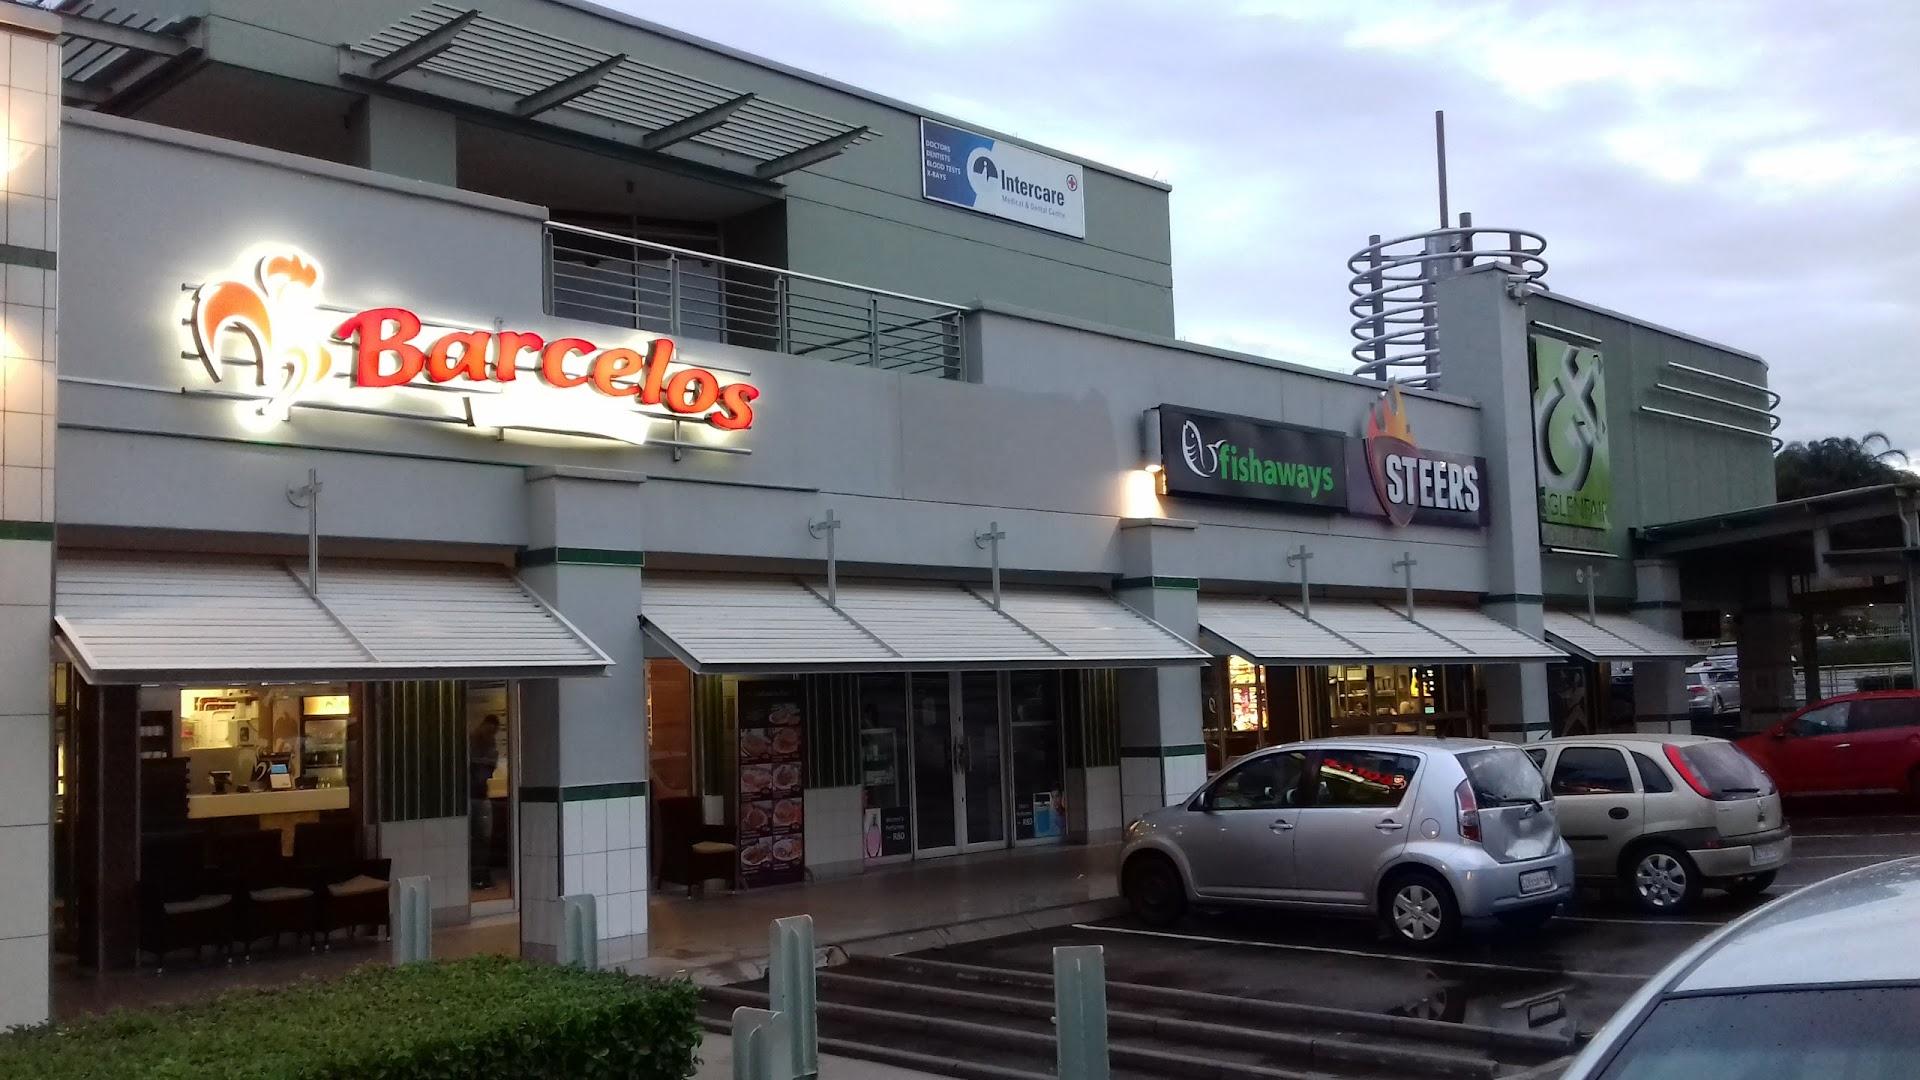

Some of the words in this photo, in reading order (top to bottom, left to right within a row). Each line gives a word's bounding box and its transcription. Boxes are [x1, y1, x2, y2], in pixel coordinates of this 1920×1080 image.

[925, 140, 951, 153] DOCTORS
[926, 159, 945, 171] BLOOD
[945, 165, 961, 175] TESTS
[926, 169, 947, 181] X-RAYS
[1001, 169, 1065, 206] Intercare
[332, 306, 760, 431] Barcelos
[1217, 443, 1335, 498] fishaways
[1385, 453, 1481, 513] STEERS
